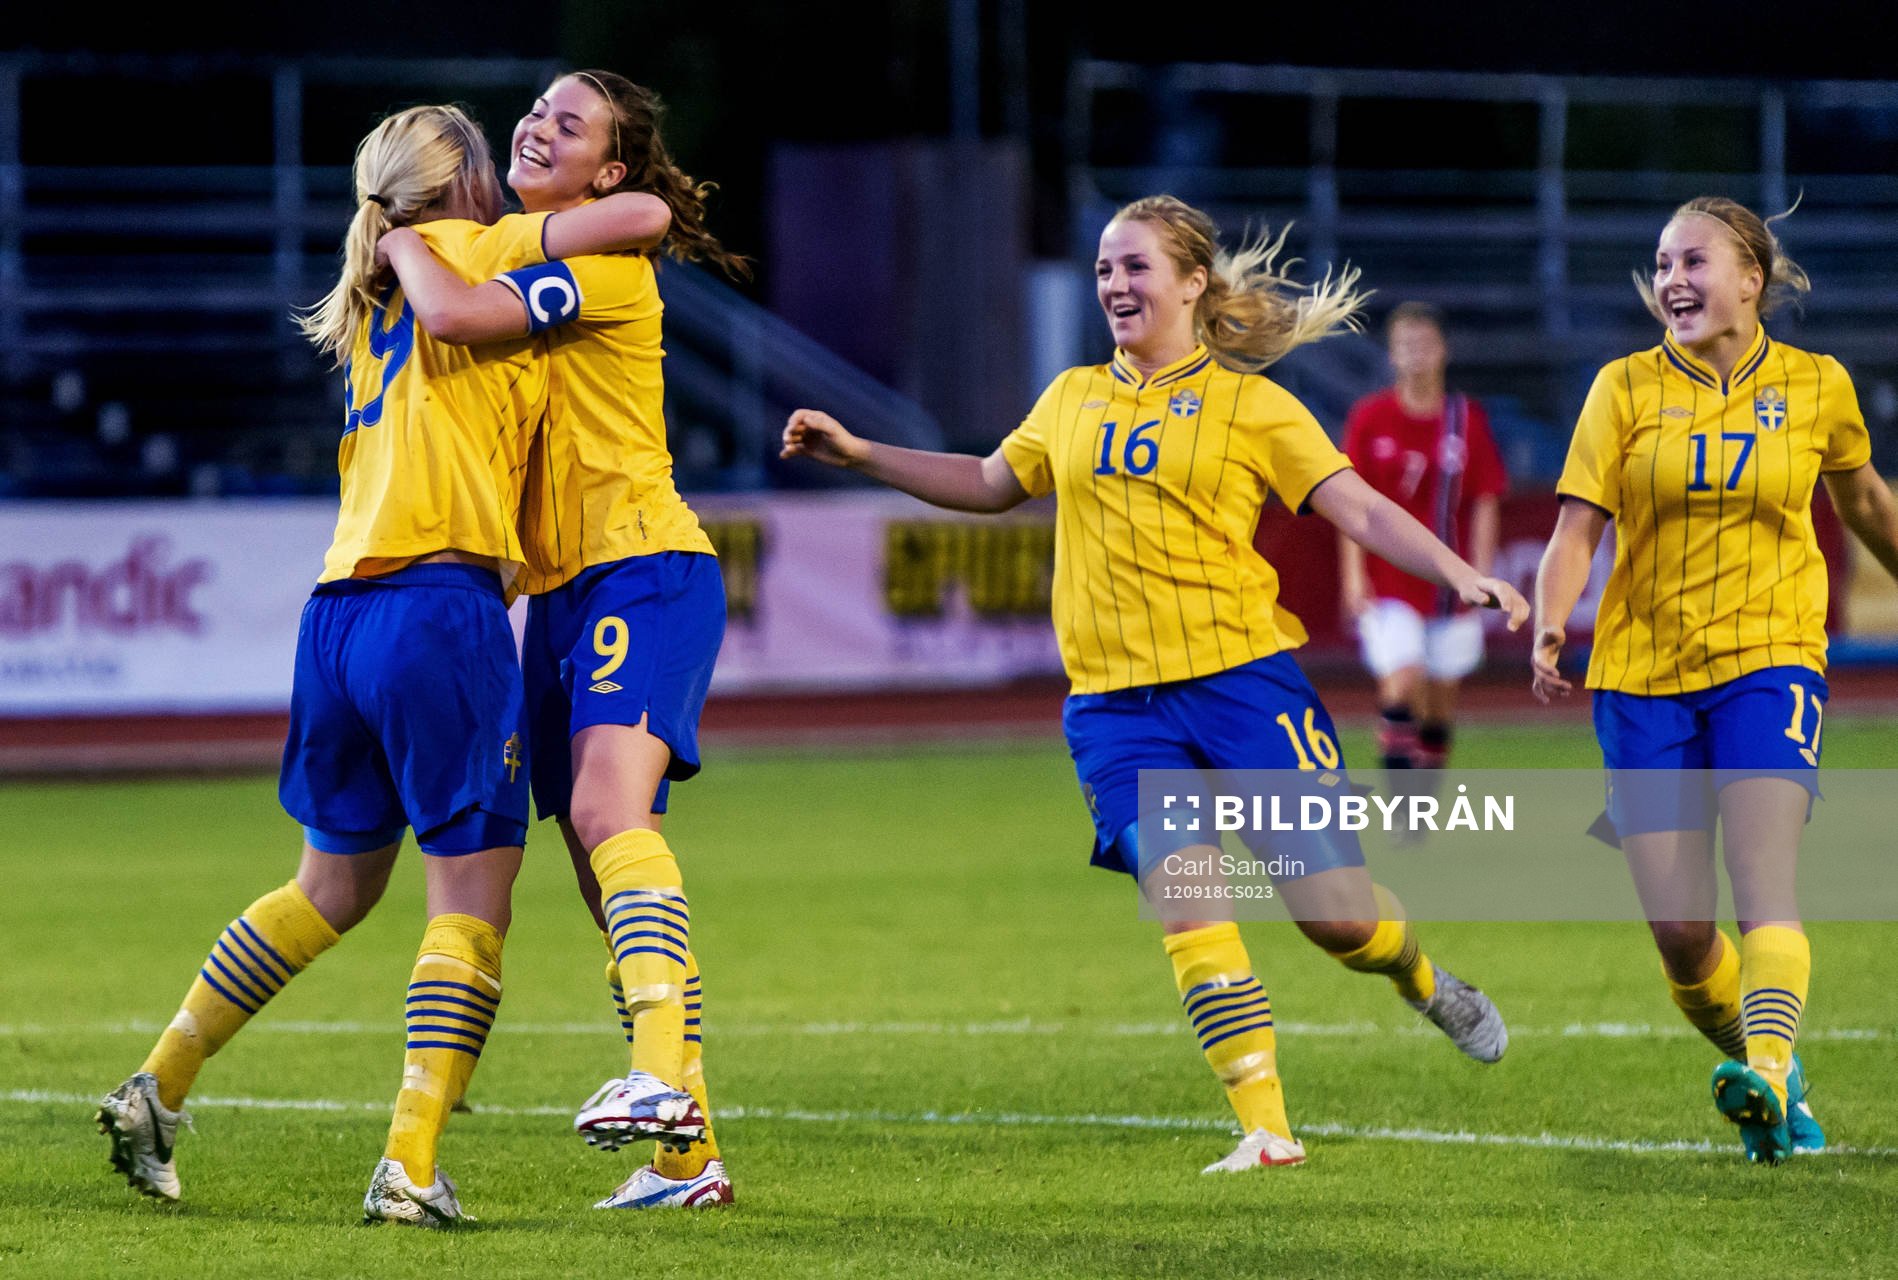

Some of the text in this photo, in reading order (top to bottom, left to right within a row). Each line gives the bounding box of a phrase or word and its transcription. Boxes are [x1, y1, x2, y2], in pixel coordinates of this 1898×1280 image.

[529, 276, 576, 323] C
[1094, 420, 1160, 476] 16
[1687, 432, 1756, 491] 17
[591, 616, 629, 681] 9
[1276, 707, 1339, 772] 16
